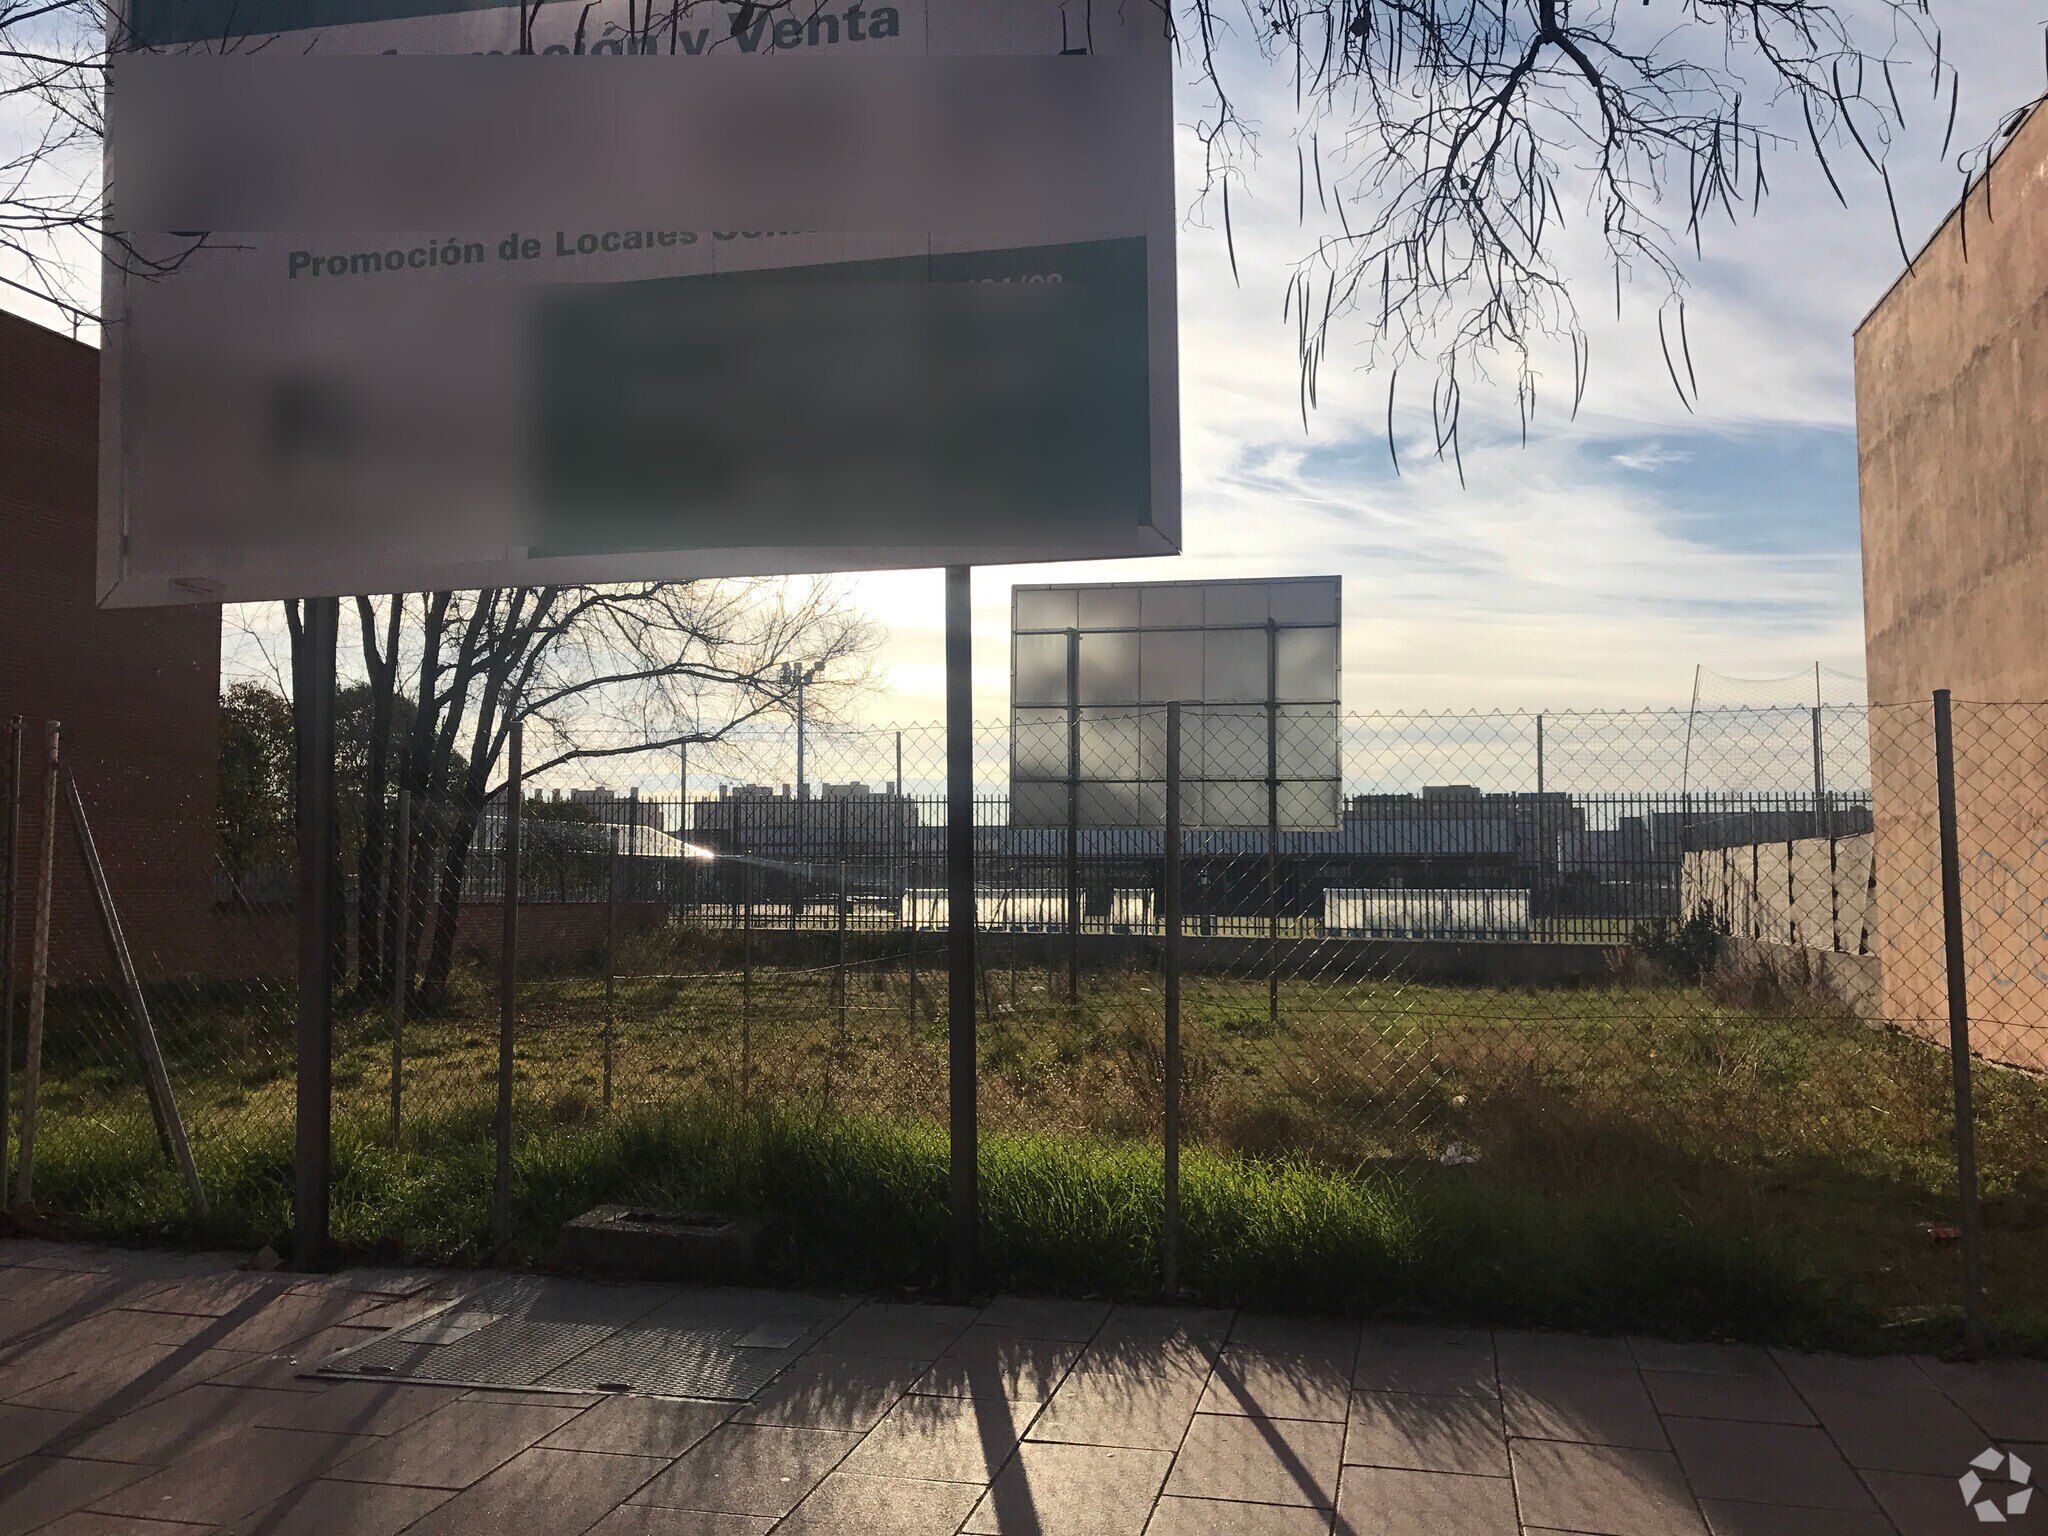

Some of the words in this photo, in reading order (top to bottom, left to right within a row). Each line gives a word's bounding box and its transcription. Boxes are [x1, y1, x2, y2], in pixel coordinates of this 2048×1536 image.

[728, 5, 899, 54] Venta
[288, 237, 485, 279] Promoción
[498, 232, 541, 260] de
[556, 231, 697, 256] Locales
